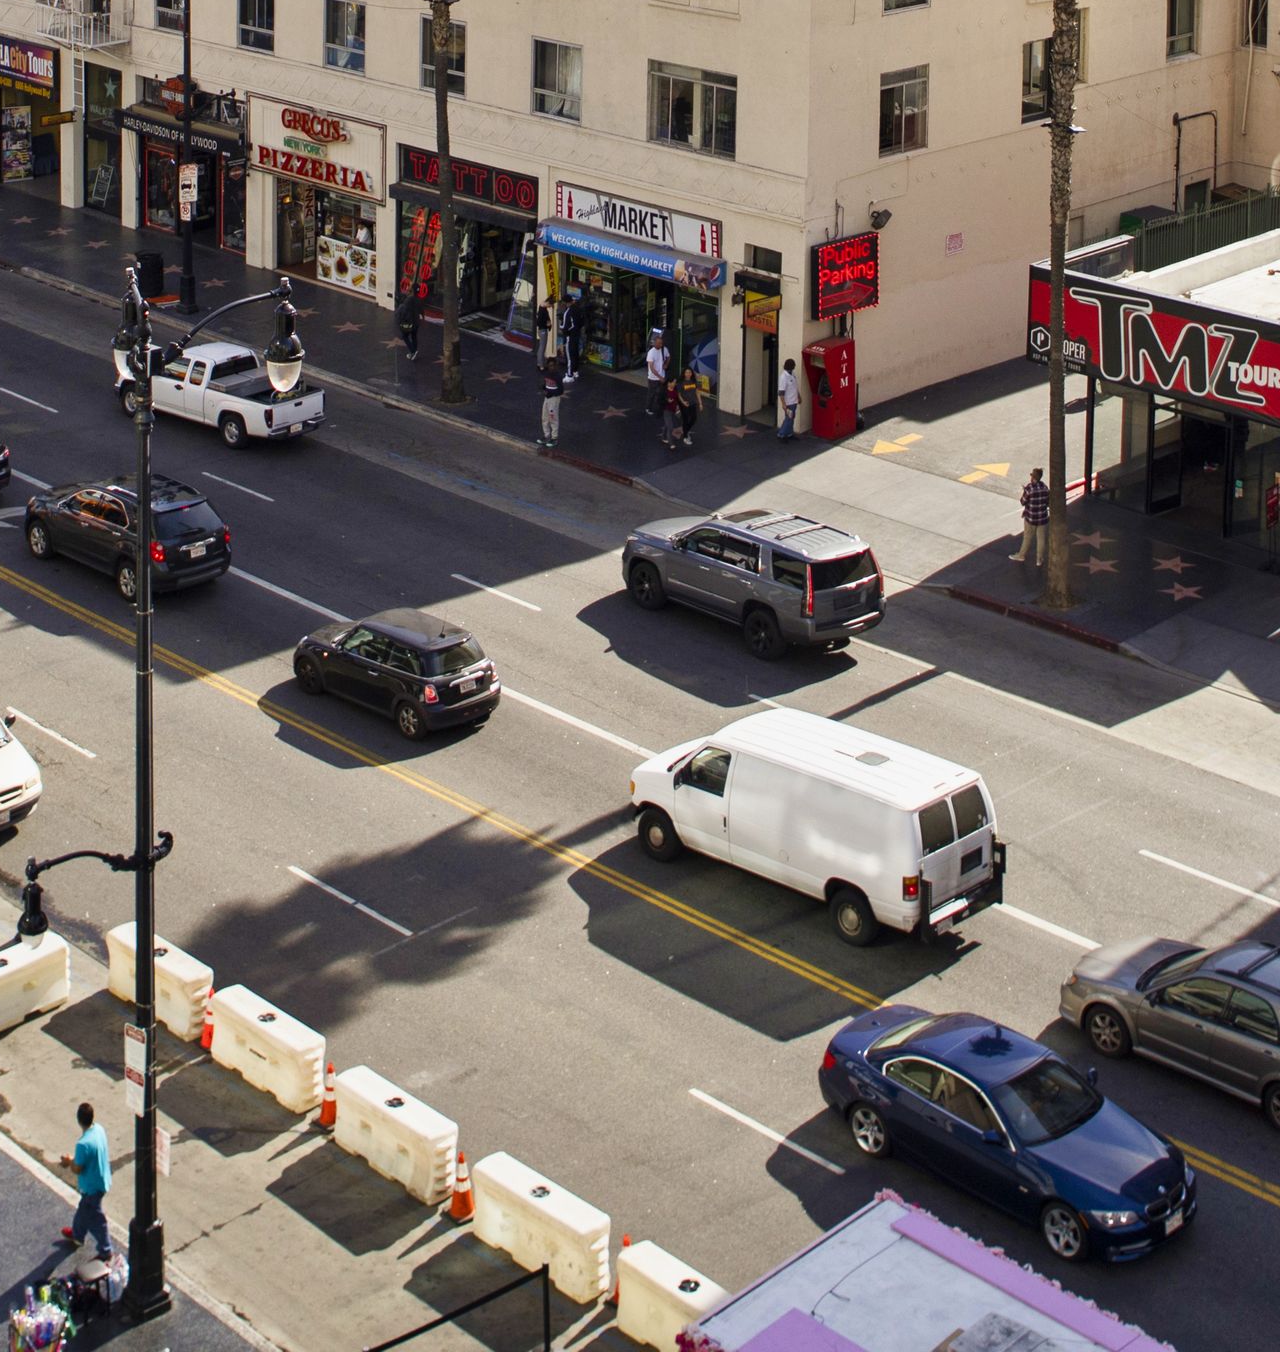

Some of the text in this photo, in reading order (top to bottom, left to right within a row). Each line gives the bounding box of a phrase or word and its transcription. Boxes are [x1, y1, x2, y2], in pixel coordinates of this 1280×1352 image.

[0, 43, 10, 67] LA
[10, 46, 27, 73] City
[27, 51, 54, 78] Tours
[123, 116, 170, 138] HARLEY-DAVIDSON
[171, 130, 180, 142] OF
[180, 132, 218, 150] HLYWOOD
[258, 145, 369, 192] PIZZERIA
[409, 151, 535, 209] TATTOO
[604, 201, 669, 242] MARKET
[551, 232, 673, 274] WELCOME TO HIGHLAND MARKET
[823, 240, 871, 267] Public
[820, 261, 875, 288] Parking
[1063, 339, 1086, 360] OPER
[1070, 287, 1266, 406] TMZ
[840, 350, 849, 388] ATM
